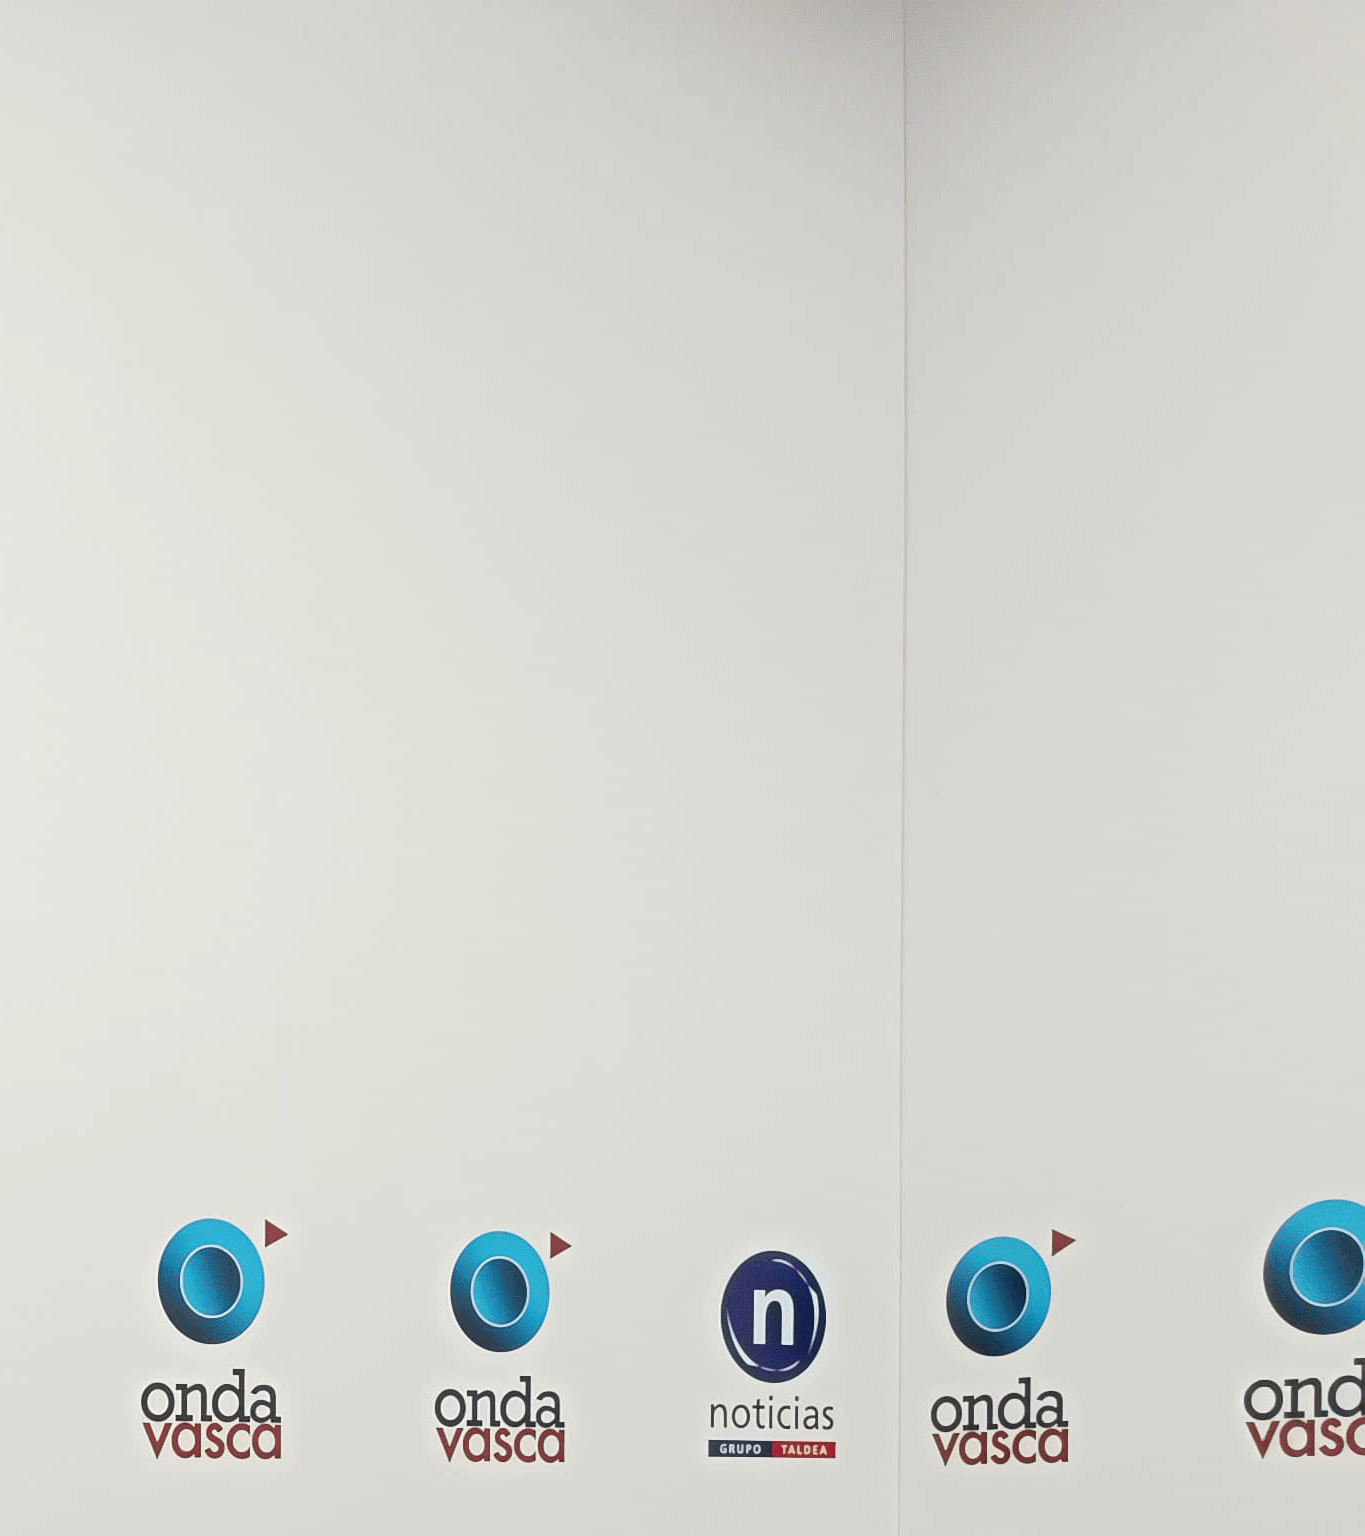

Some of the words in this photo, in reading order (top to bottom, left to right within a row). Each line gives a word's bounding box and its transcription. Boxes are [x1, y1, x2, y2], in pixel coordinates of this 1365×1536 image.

[753, 1289, 795, 1346] n
[140, 1368, 282, 1424] onda
[434, 1375, 566, 1430] onda
[930, 1376, 1069, 1432] onda
[1243, 1357, 1365, 1421] ond
[710, 1395, 834, 1431] noticias
[142, 1421, 282, 1460] vasca
[436, 1426, 566, 1464] vasca
[719, 1443, 762, 1455] GRUPO
[780, 1444, 828, 1456] TALDEA
[932, 1428, 1069, 1467] vasca
[1245, 1416, 1365, 1460] vasc
